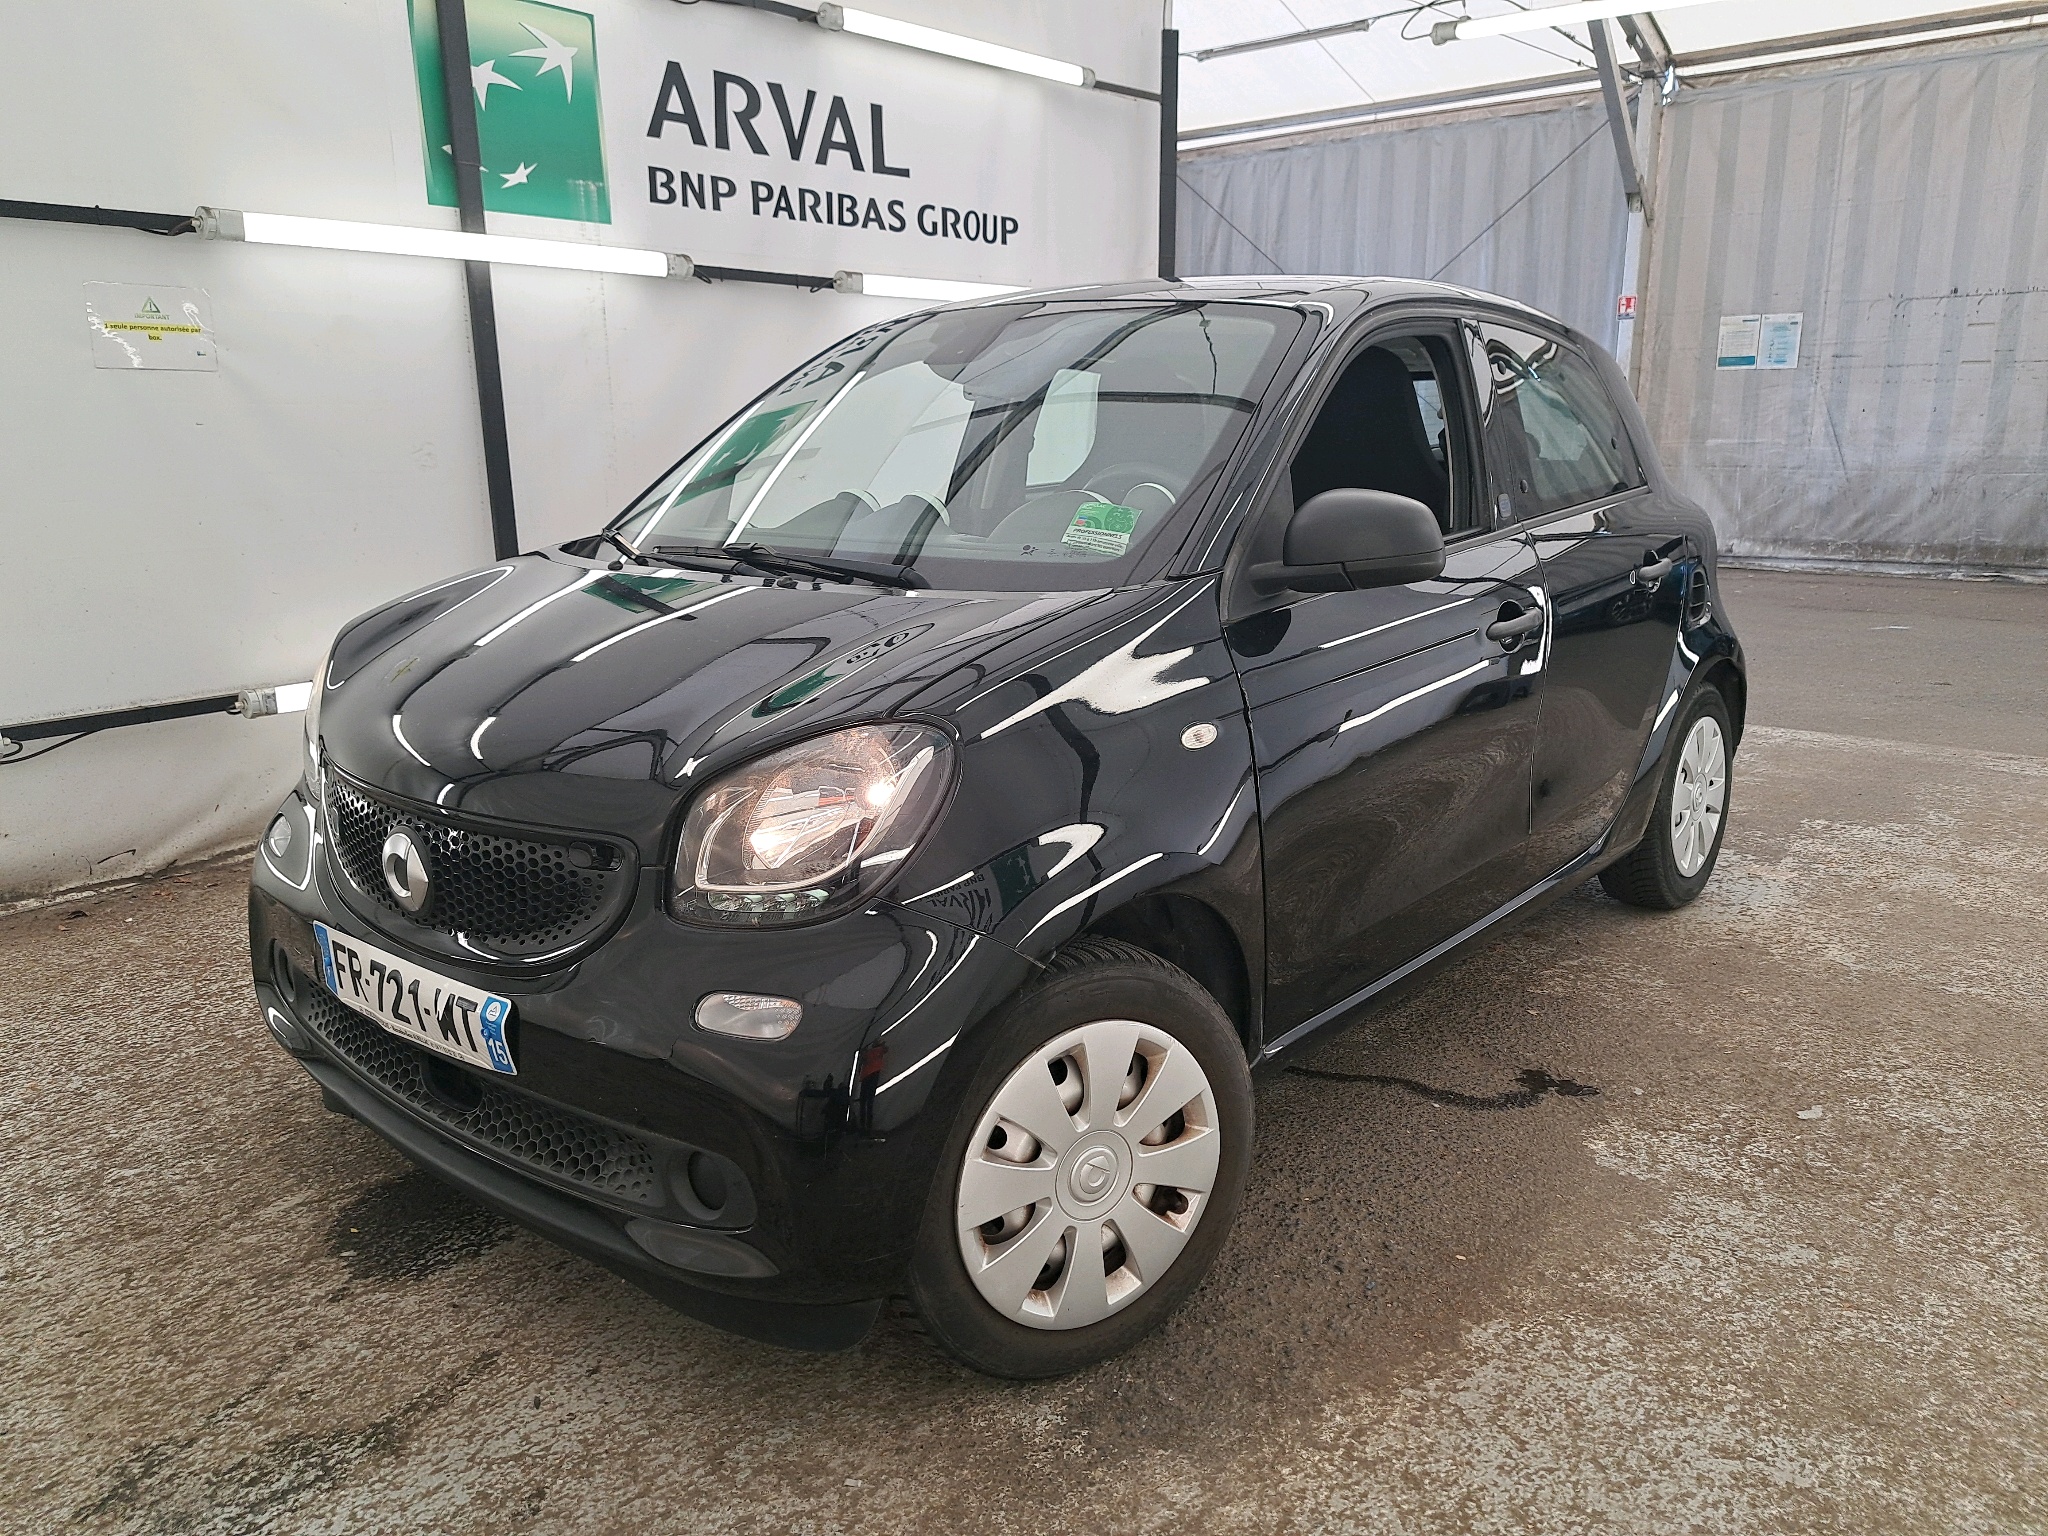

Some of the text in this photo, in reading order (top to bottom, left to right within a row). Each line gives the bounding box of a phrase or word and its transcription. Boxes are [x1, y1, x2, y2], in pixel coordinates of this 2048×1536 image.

[647, 60, 910, 178] ARVAL
[648, 166, 1019, 245] BNP PARIBAS GROUP
[332, 940, 478, 1052] FR-721-WT
[488, 1038, 509, 1065] 15
